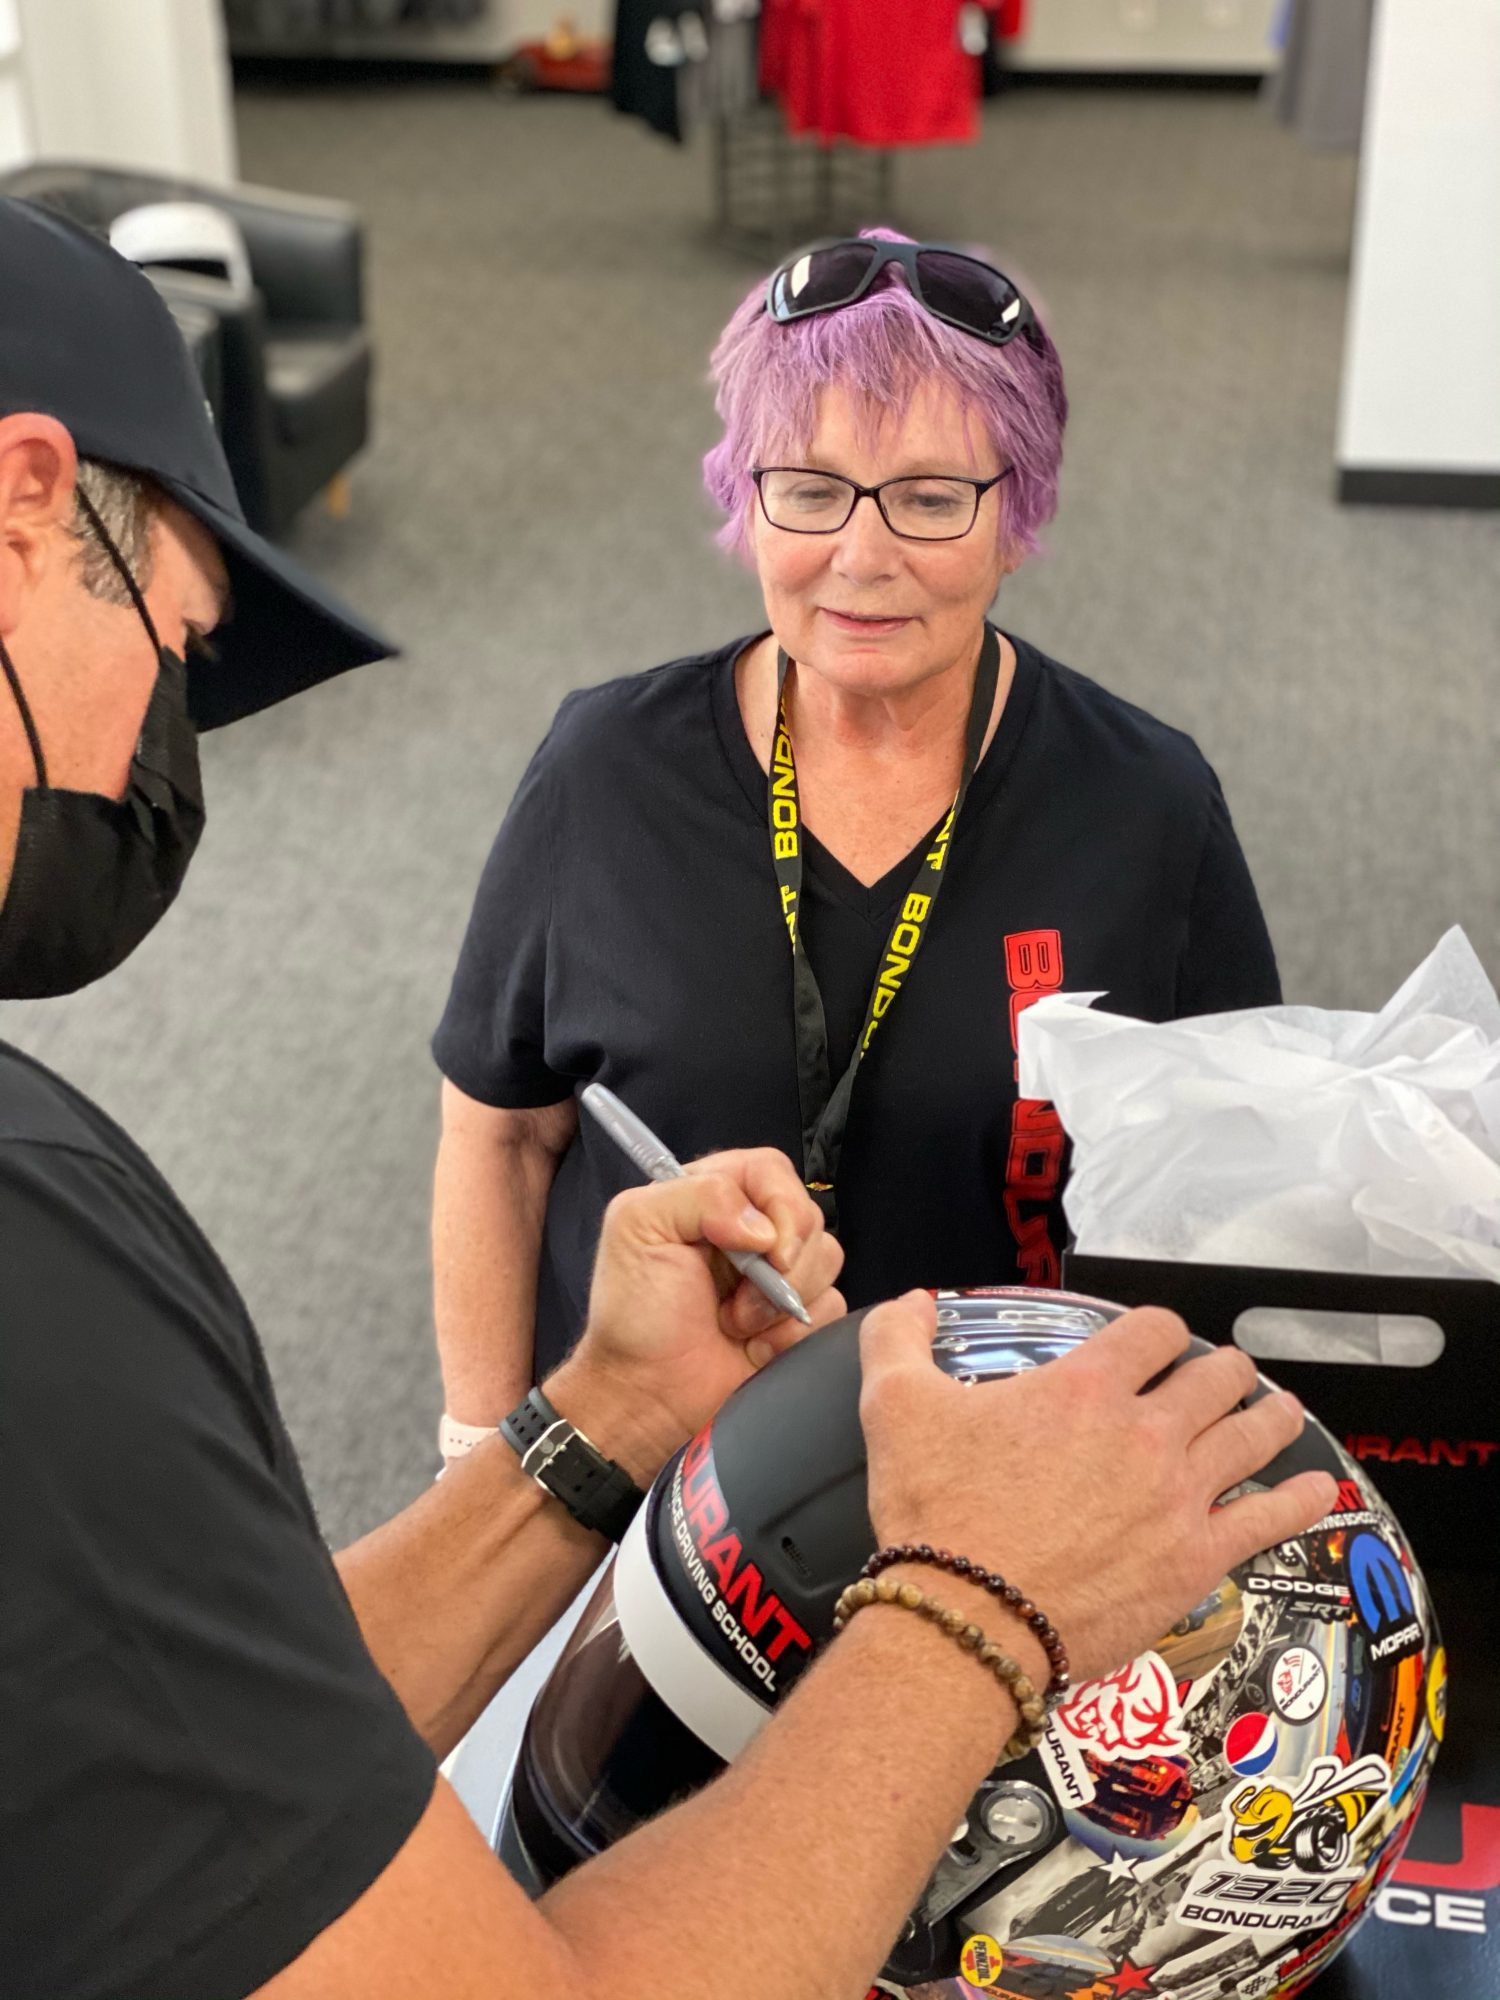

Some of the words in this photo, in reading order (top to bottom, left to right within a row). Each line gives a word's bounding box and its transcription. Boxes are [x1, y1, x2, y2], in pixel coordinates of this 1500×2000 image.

[676, 1518, 717, 1605] DRIVING
[711, 1599, 778, 1692] SCHOOL
[1247, 1577, 1351, 1597] DODGE
[1289, 1601, 1351, 1619] SRT
[1370, 1622, 1421, 1661] MOPAR
[1194, 1871, 1362, 1907] 1320
